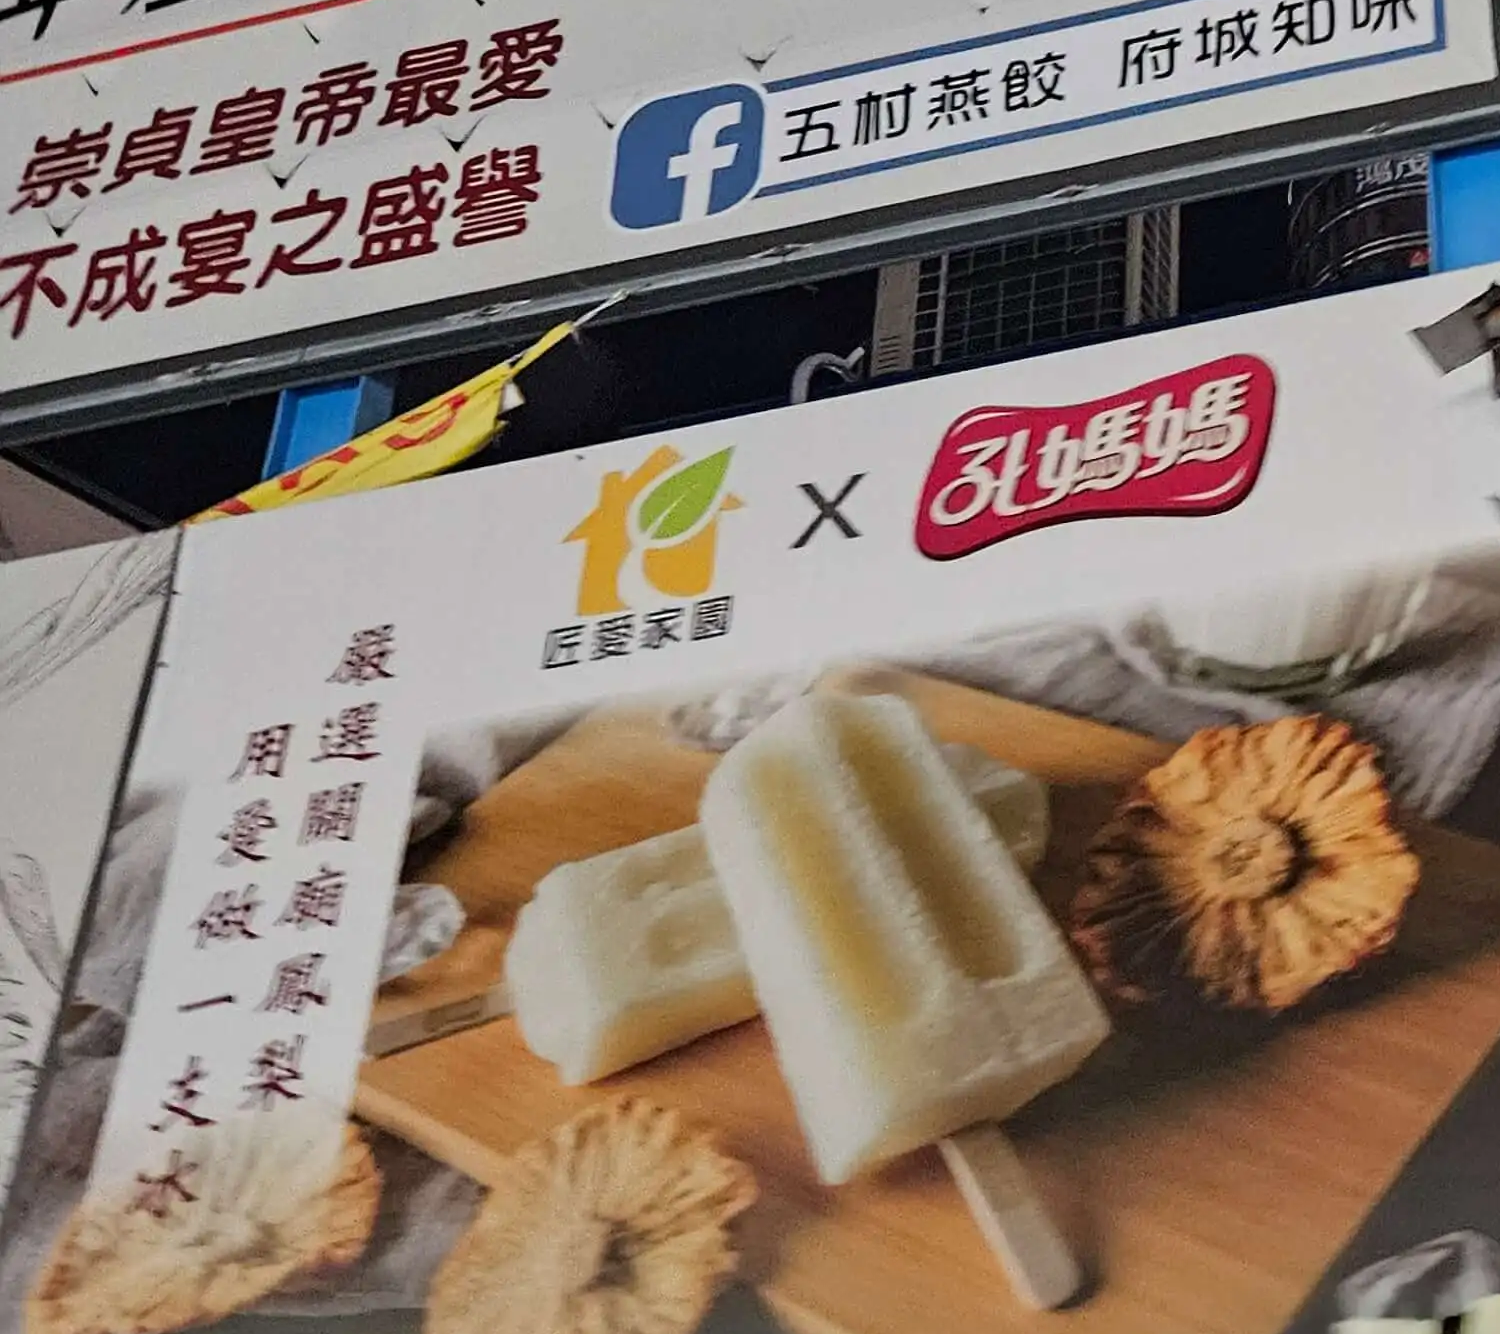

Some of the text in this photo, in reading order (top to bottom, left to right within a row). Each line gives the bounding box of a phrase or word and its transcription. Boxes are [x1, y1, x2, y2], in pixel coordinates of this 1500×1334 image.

[9, 19, 564, 214] 崇貞皇帝最愛
[780, 53, 1068, 163] 五村燕餃
[0, 145, 542, 340] 不成宴之盛譽
